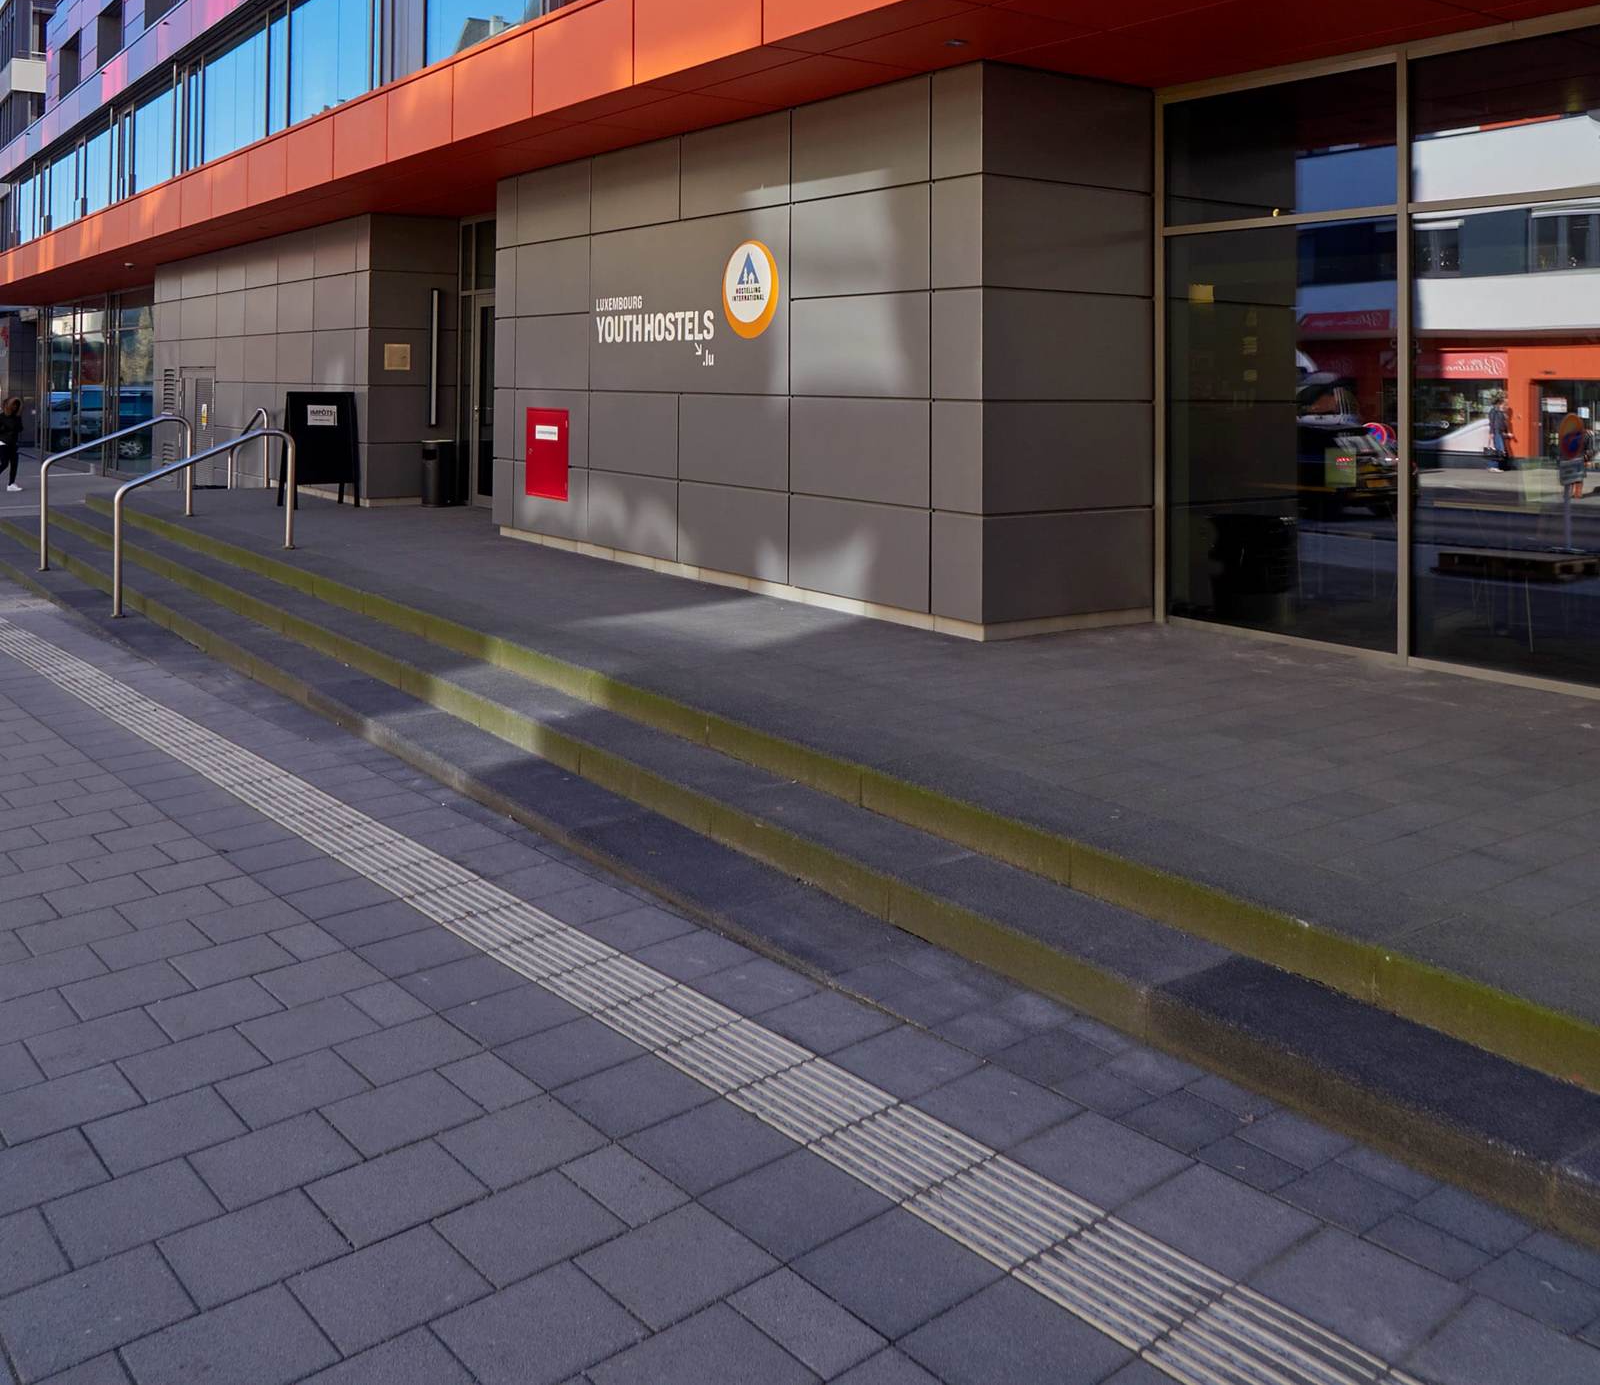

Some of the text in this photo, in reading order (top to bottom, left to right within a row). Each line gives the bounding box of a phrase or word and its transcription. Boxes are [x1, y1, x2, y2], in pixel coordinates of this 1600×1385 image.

[732, 294, 764, 302] INTERNATIONAL
[735, 286, 761, 295] HOSTELLING
[595, 295, 643, 312] LUXEMBOURG
[596, 309, 715, 343] YOUTH HOSTELS
[702, 349, 714, 366] .lu
